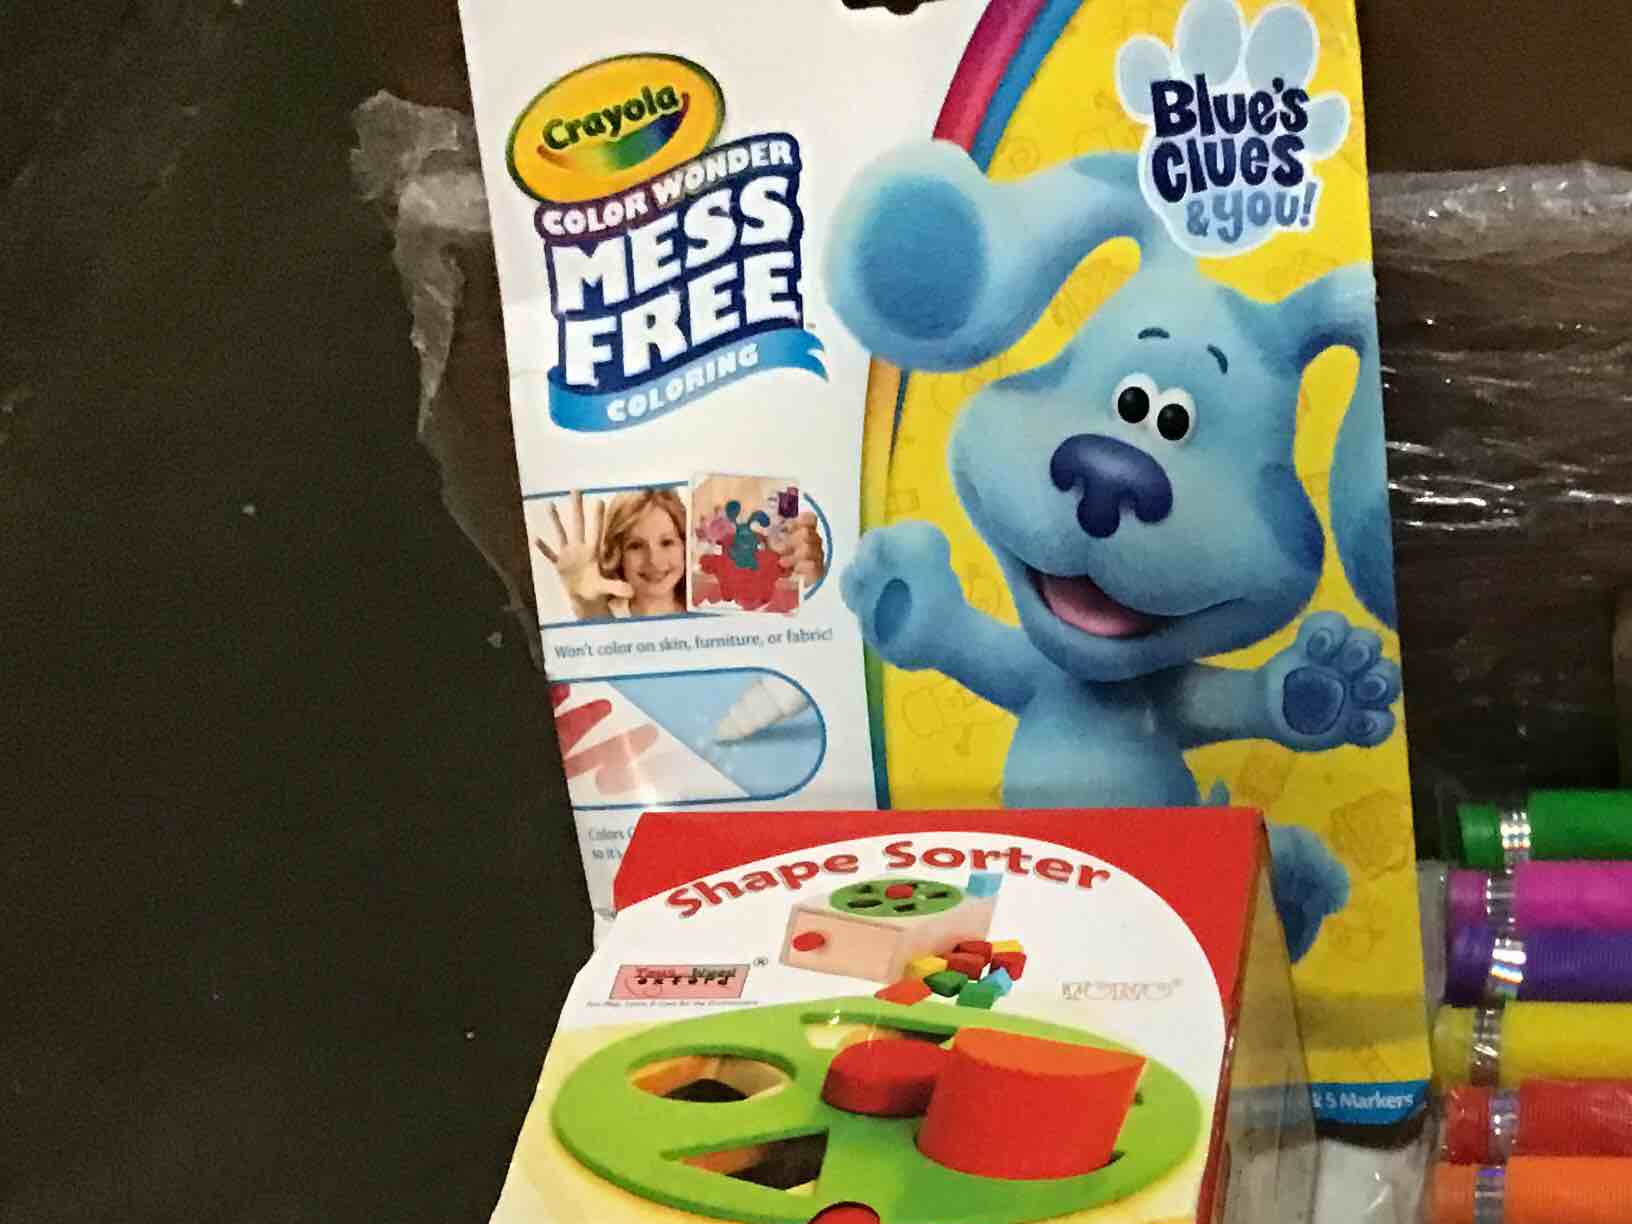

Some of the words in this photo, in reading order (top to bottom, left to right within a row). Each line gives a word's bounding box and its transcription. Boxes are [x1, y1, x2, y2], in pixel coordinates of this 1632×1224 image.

[542, 85, 680, 150] Crayola
[1150, 73, 1309, 138] Blue's
[541, 191, 647, 236] COLOR
[652, 140, 793, 206] WONDER
[1151, 134, 1305, 203] Clues
[550, 175, 794, 312] MESS
[1211, 181, 1318, 244] you!
[564, 251, 799, 387] FREE
[606, 342, 760, 423] COLORING
[553, 642, 594, 660] Won't
[597, 641, 633, 656] color
[636, 640, 656, 654] on
[659, 634, 692, 652] skin,
[695, 633, 763, 650] furniture,
[767, 632, 783, 645] or
[665, 852, 859, 919] Shape
[884, 840, 1111, 890] Sorter
[1340, 1089, 1415, 1109] Markers
